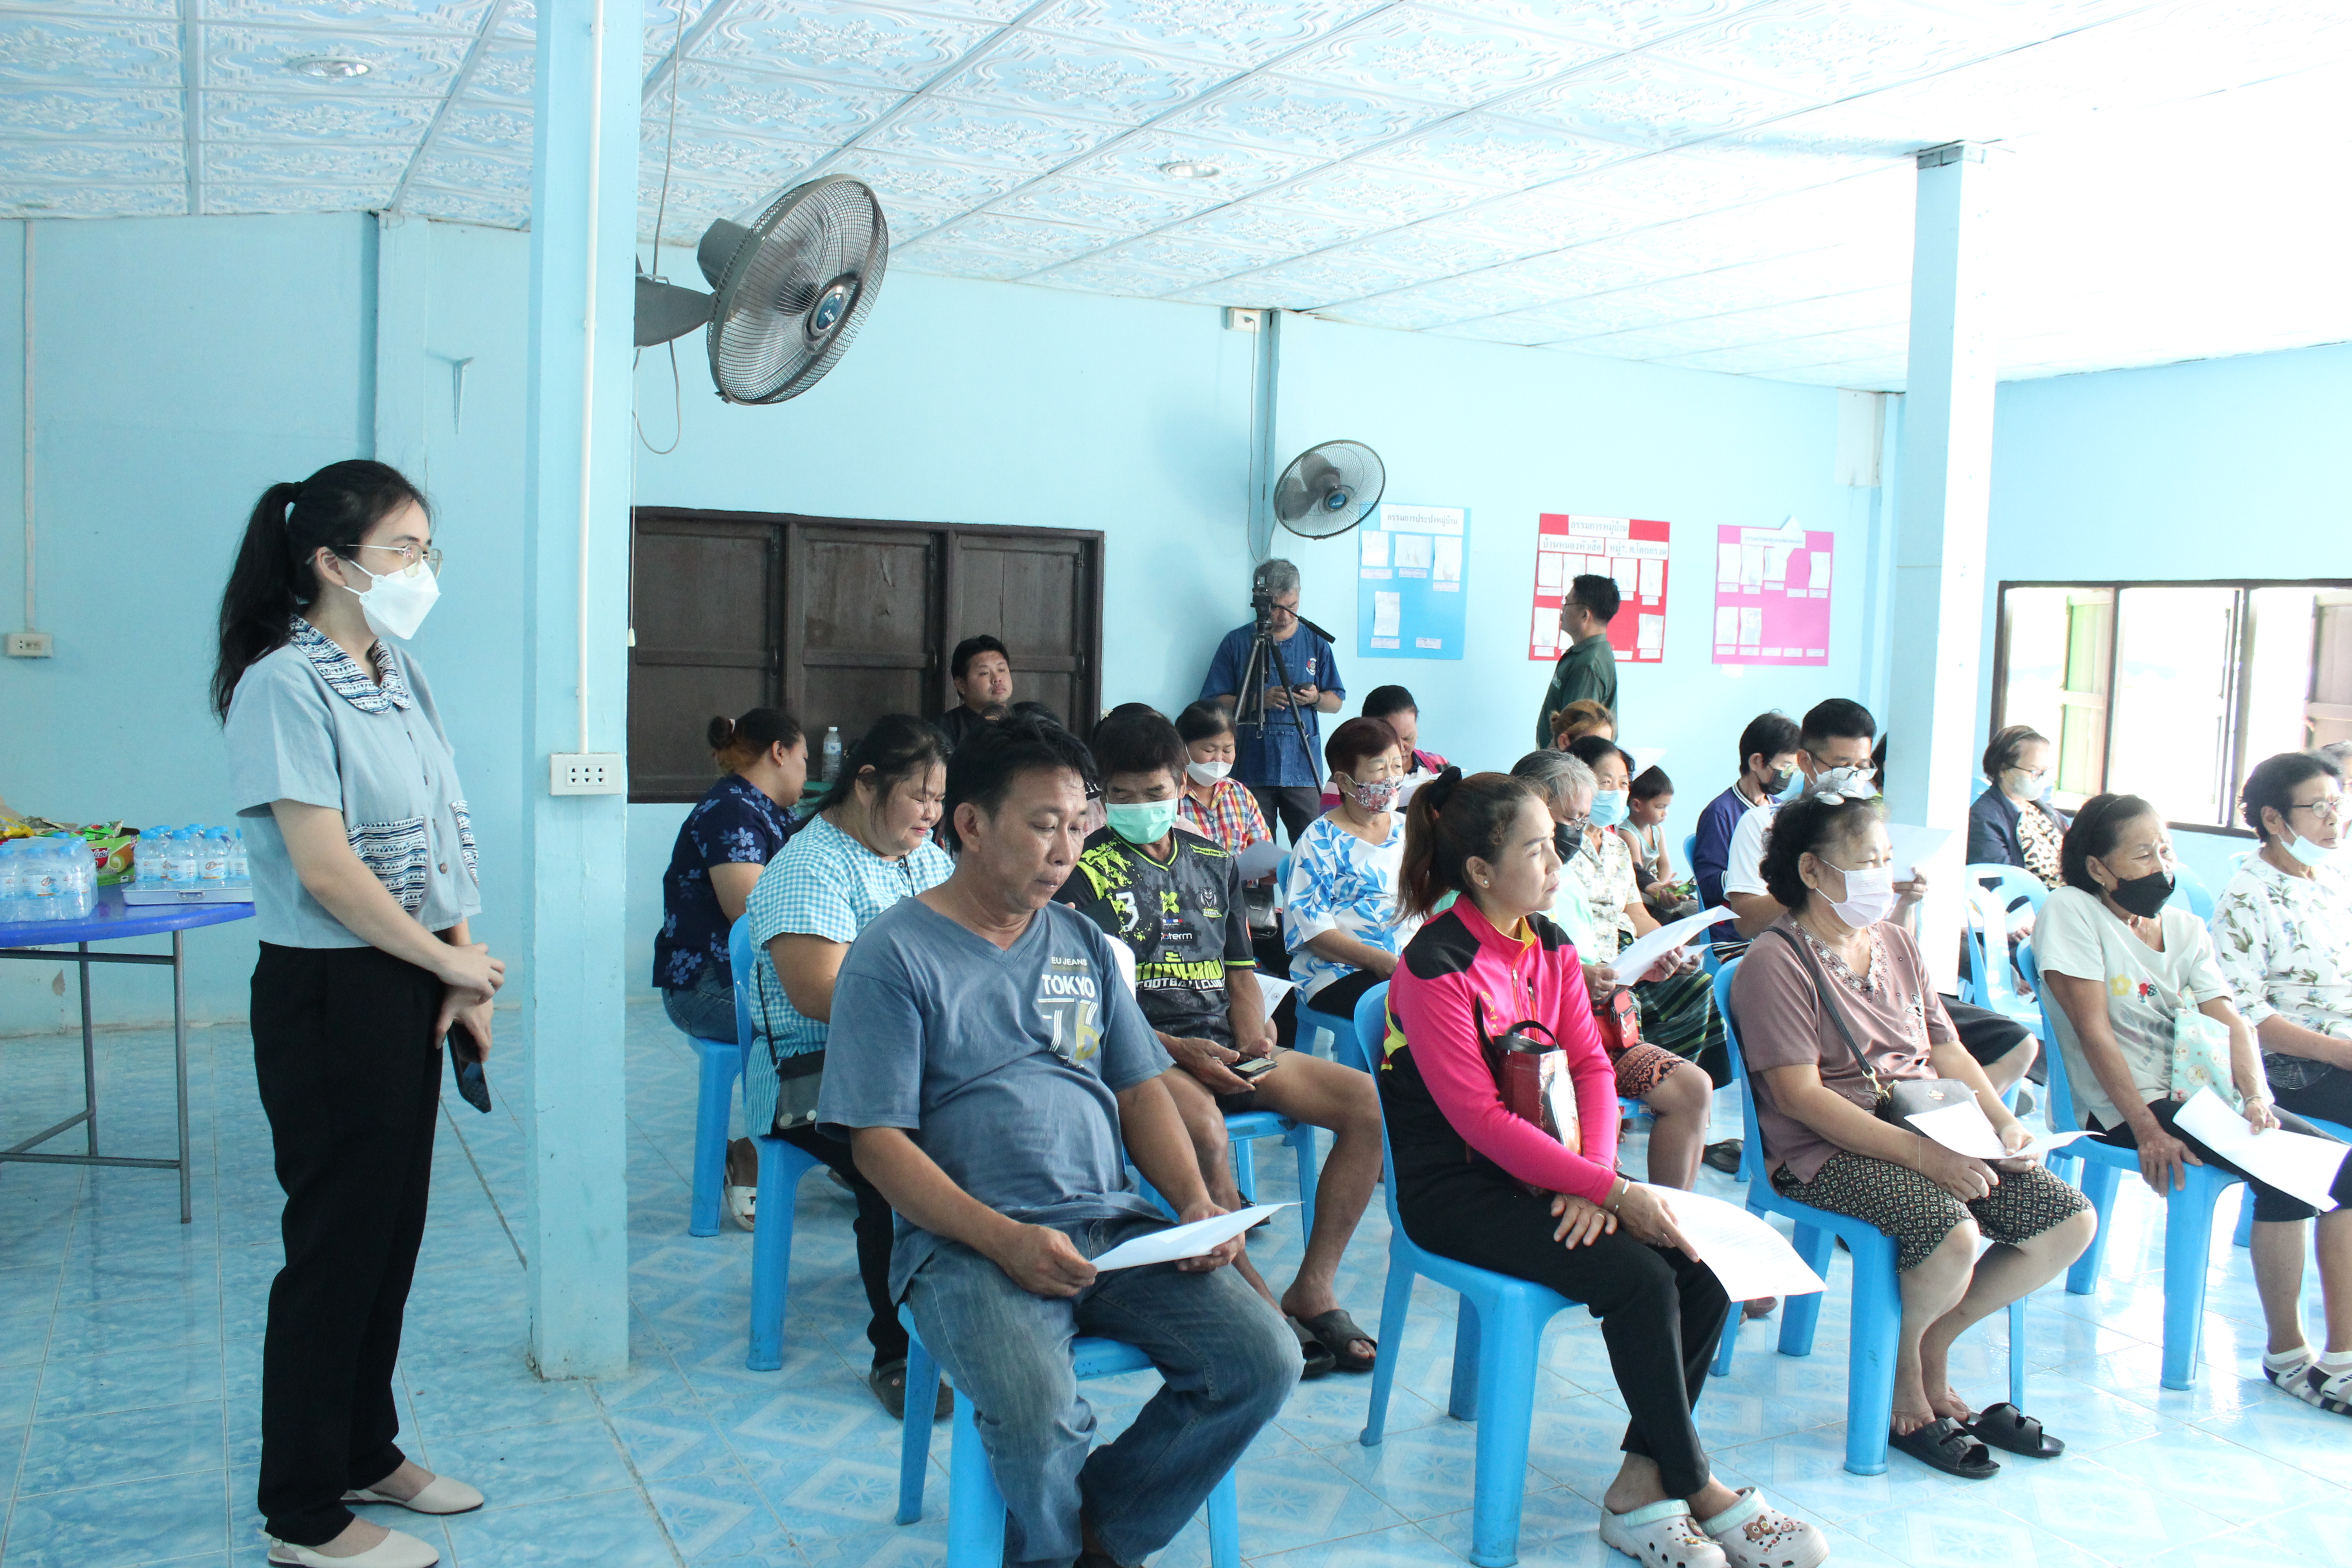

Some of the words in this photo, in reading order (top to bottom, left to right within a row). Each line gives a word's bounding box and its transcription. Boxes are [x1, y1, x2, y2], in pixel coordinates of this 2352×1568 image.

[1387, 513, 1458, 527] กรรมการประปาหมู่บ้าน
[1570, 520, 1628, 534] กรรมการหมู่บ้าน
[1161, 932, 1192, 941] oterm
[1051, 956, 1062, 965] EU
[1063, 958, 1088, 966] JEANS
[1042, 974, 1095, 998] TOKYO
[1201, 979, 1224, 989] CLUB
